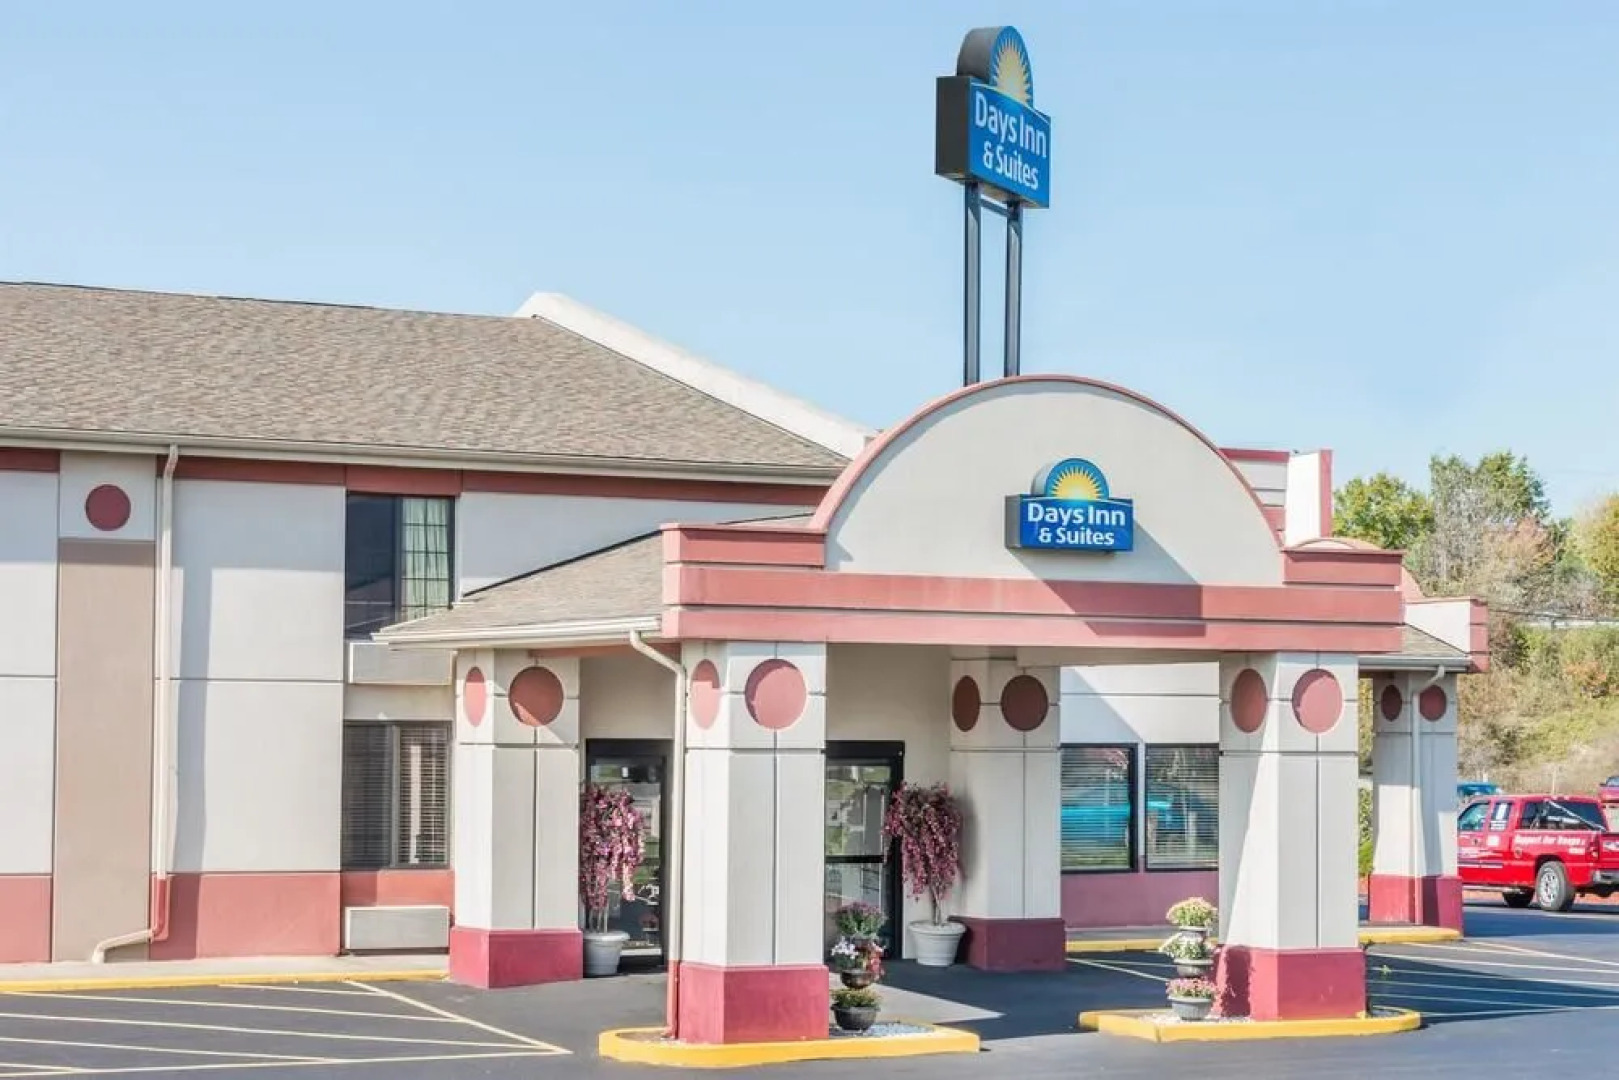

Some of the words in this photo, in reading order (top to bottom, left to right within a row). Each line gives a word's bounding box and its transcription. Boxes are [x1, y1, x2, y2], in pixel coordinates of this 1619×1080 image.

[975, 91, 1017, 143] Days
[1019, 113, 1047, 158] Inn
[983, 141, 993, 169] &
[996, 145, 1038, 190] Suites
[1027, 502, 1084, 526] Days
[1087, 504, 1125, 526] Inn
[1039, 527, 1052, 544] &
[1056, 526, 1115, 546] Suites
